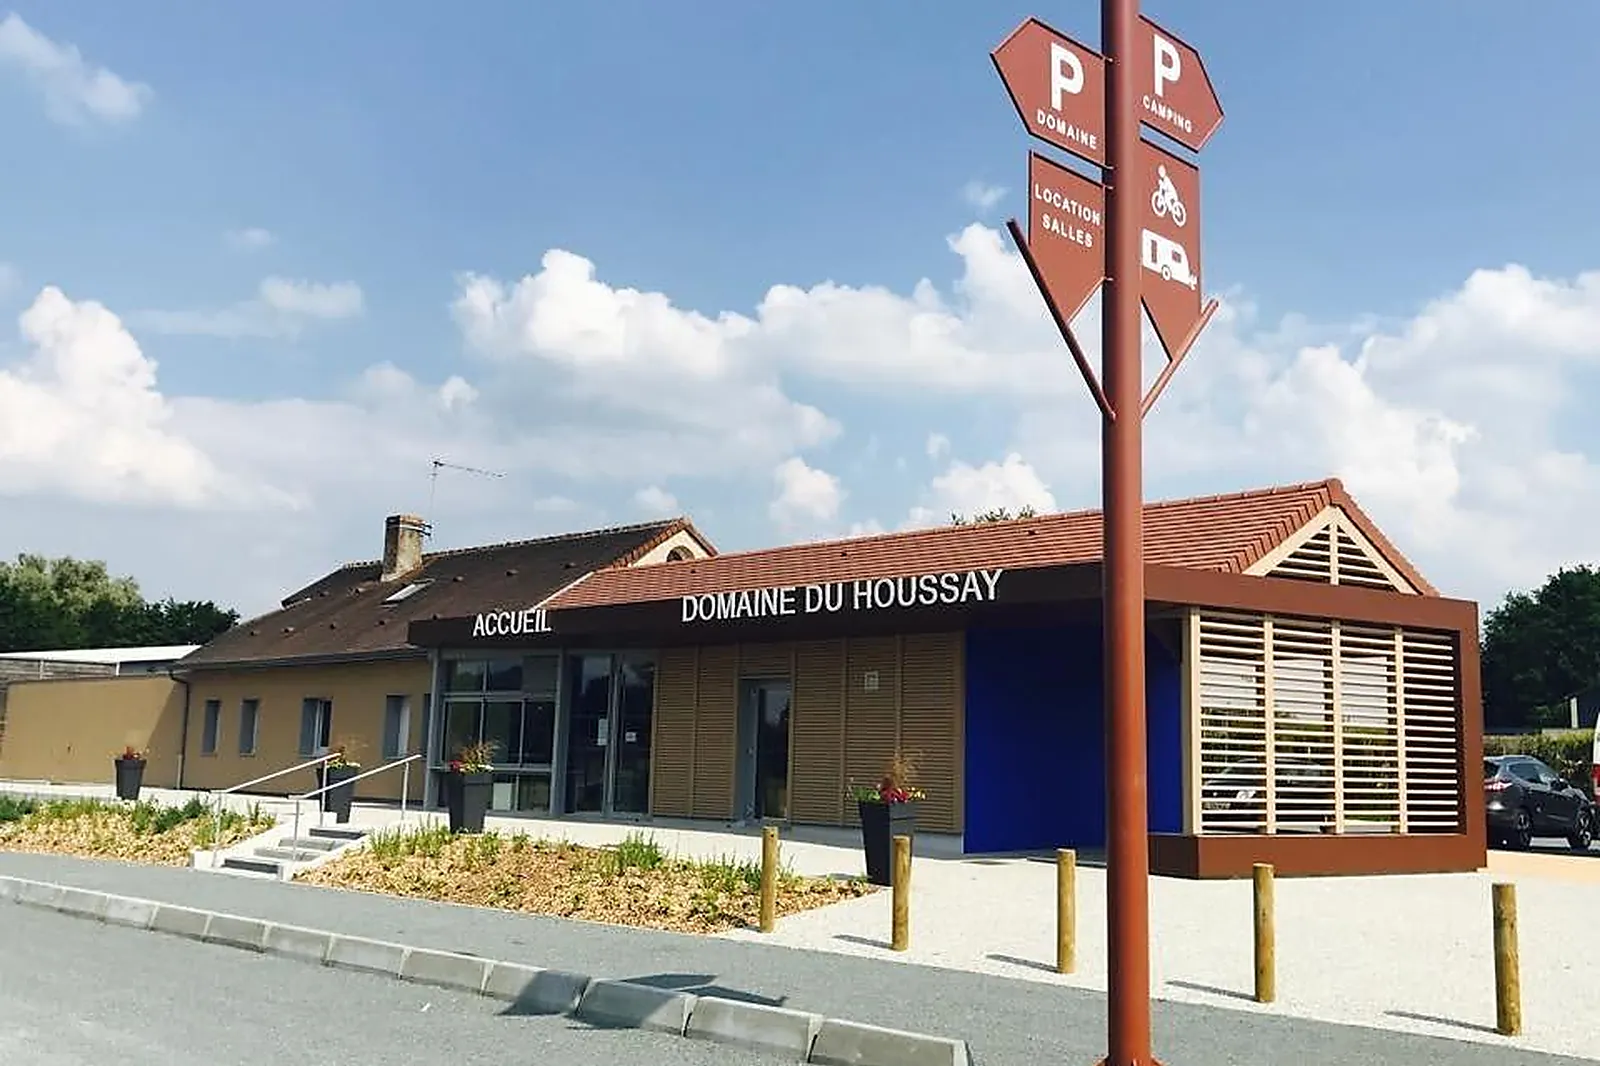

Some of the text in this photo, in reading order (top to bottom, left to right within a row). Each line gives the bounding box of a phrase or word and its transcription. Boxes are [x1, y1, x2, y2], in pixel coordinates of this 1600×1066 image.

[1051, 41, 1084, 111] P
[1154, 33, 1181, 97] P
[1036, 109, 1097, 149] DOMAINE
[1142, 95, 1192, 133] CAMPING
[1034, 183, 1100, 226] LOCATION
[1042, 213, 1093, 248] SALLES
[681, 568, 1002, 622] DOMAINE DU HOUSSAY
[473, 609, 552, 637] ACCUEIL
